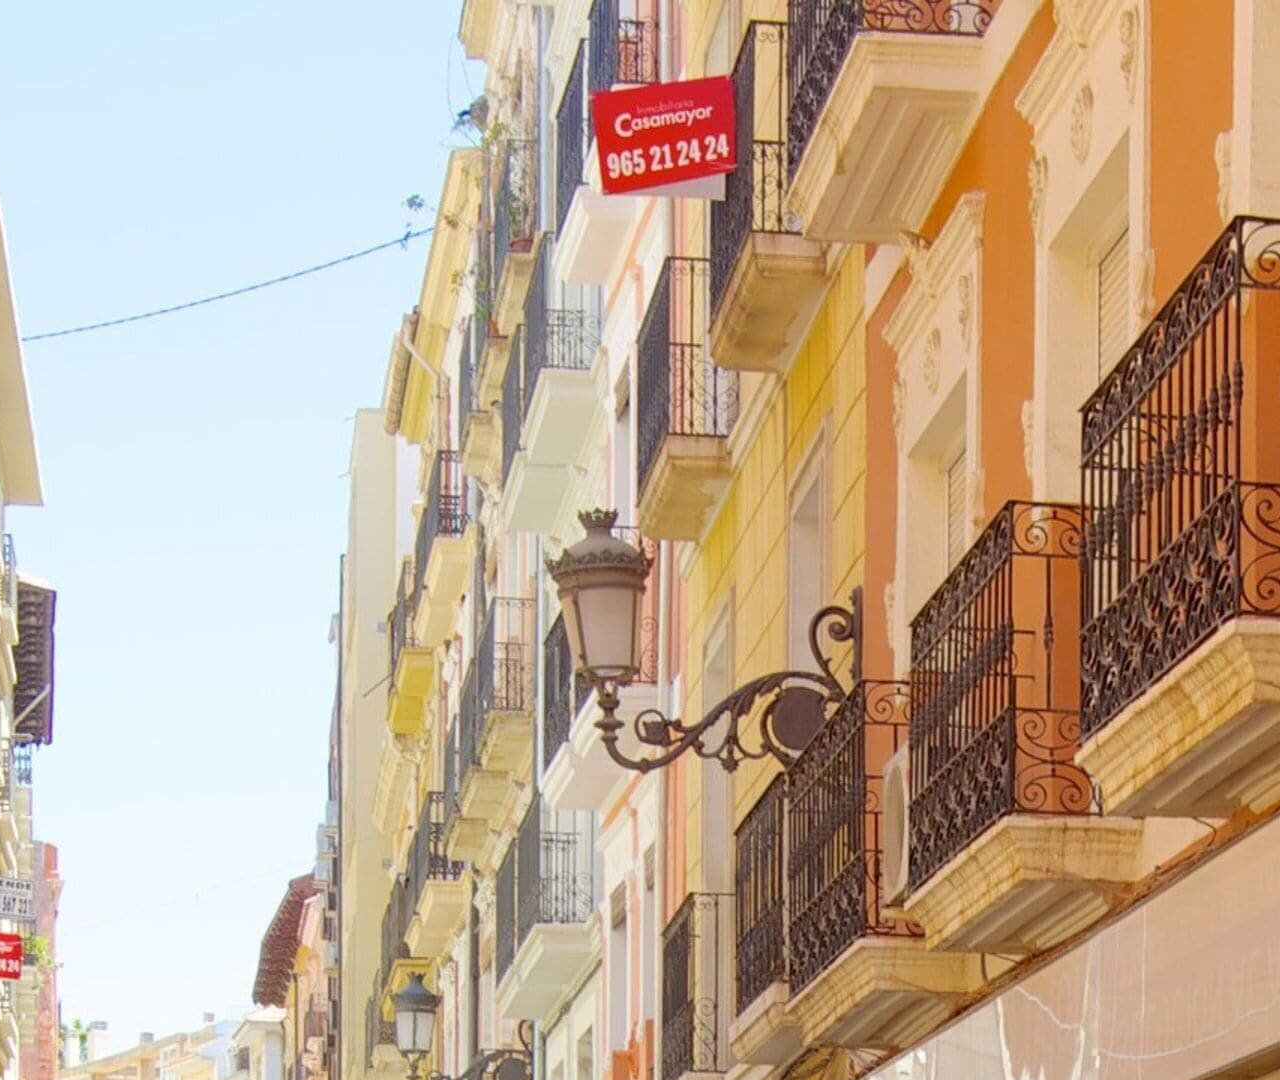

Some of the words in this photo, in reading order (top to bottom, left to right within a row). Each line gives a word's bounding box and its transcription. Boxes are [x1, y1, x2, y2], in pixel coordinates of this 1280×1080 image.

[614, 106, 713, 137] Casamayor
[606, 148, 646, 179] 965
[649, 143, 674, 172] 21
[676, 138, 701, 167] 24
[704, 133, 729, 162] 24
[7, 958, 19, 973] 24
